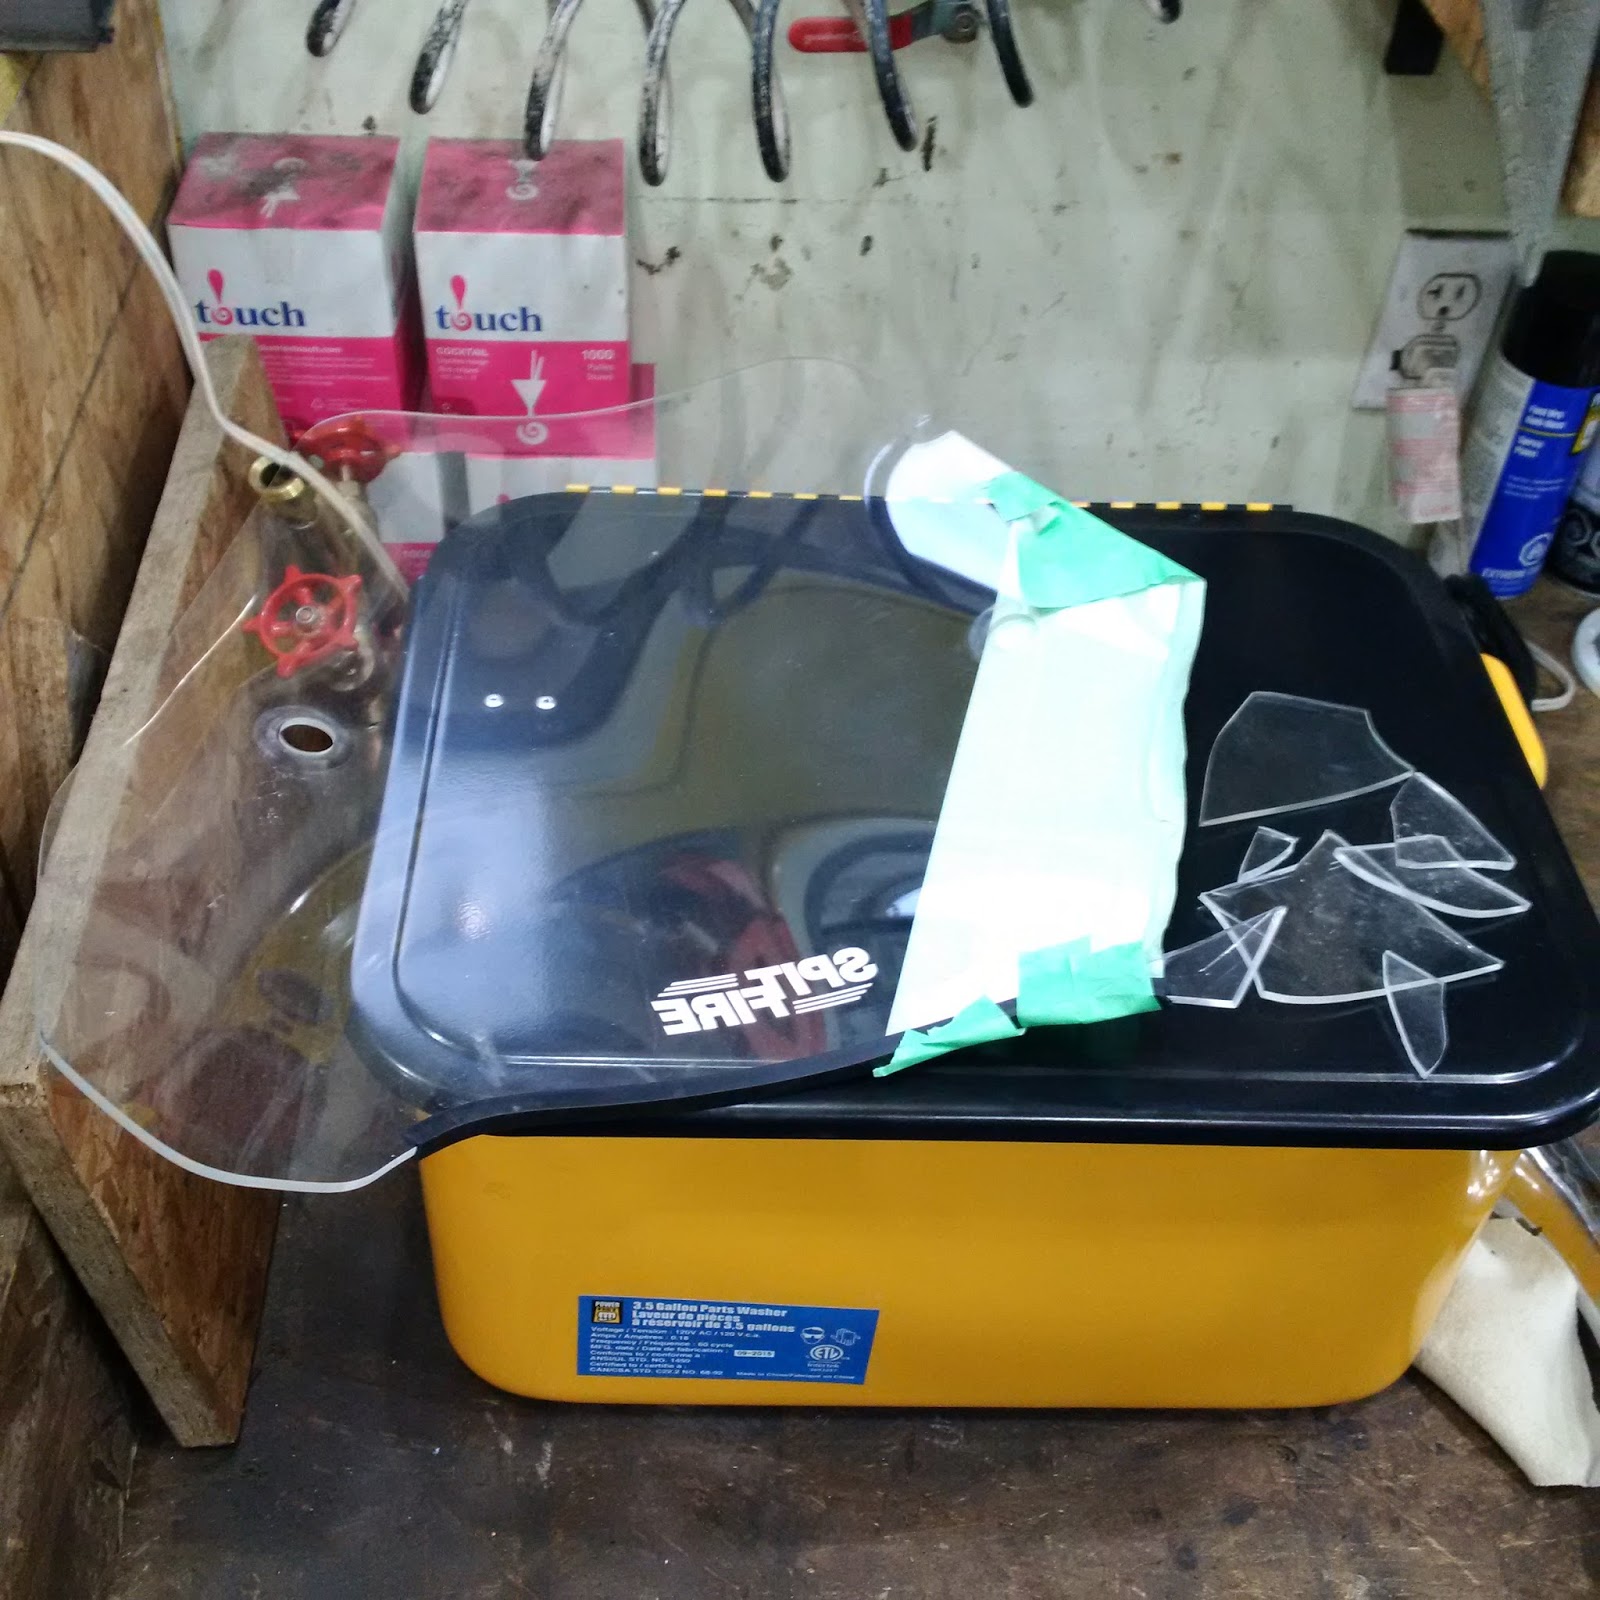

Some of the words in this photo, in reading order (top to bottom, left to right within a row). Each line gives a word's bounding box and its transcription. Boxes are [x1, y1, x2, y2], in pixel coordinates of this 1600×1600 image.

[194, 300, 306, 327] touch
[434, 305, 543, 332] touch
[581, 349, 615, 360] 1000
[633, 1301, 654, 1311] 3.5
[656, 1302, 698, 1312] Gallon
[700, 1304, 735, 1314] Parts
[736, 1306, 788, 1317] Washer
[632, 1310, 676, 1320] Laveur
[677, 1311, 694, 1321] de
[696, 1313, 741, 1322] pièces
[591, 1326, 624, 1334] Voltage
[642, 1318, 702, 1329] réservoir
[704, 1321, 721, 1329] de
[747, 1323, 796, 1333] gallons
[590, 1332, 616, 1340] Amps
[590, 1338, 637, 1346] Frequency
[677, 1346, 723, 1354] fabrication
